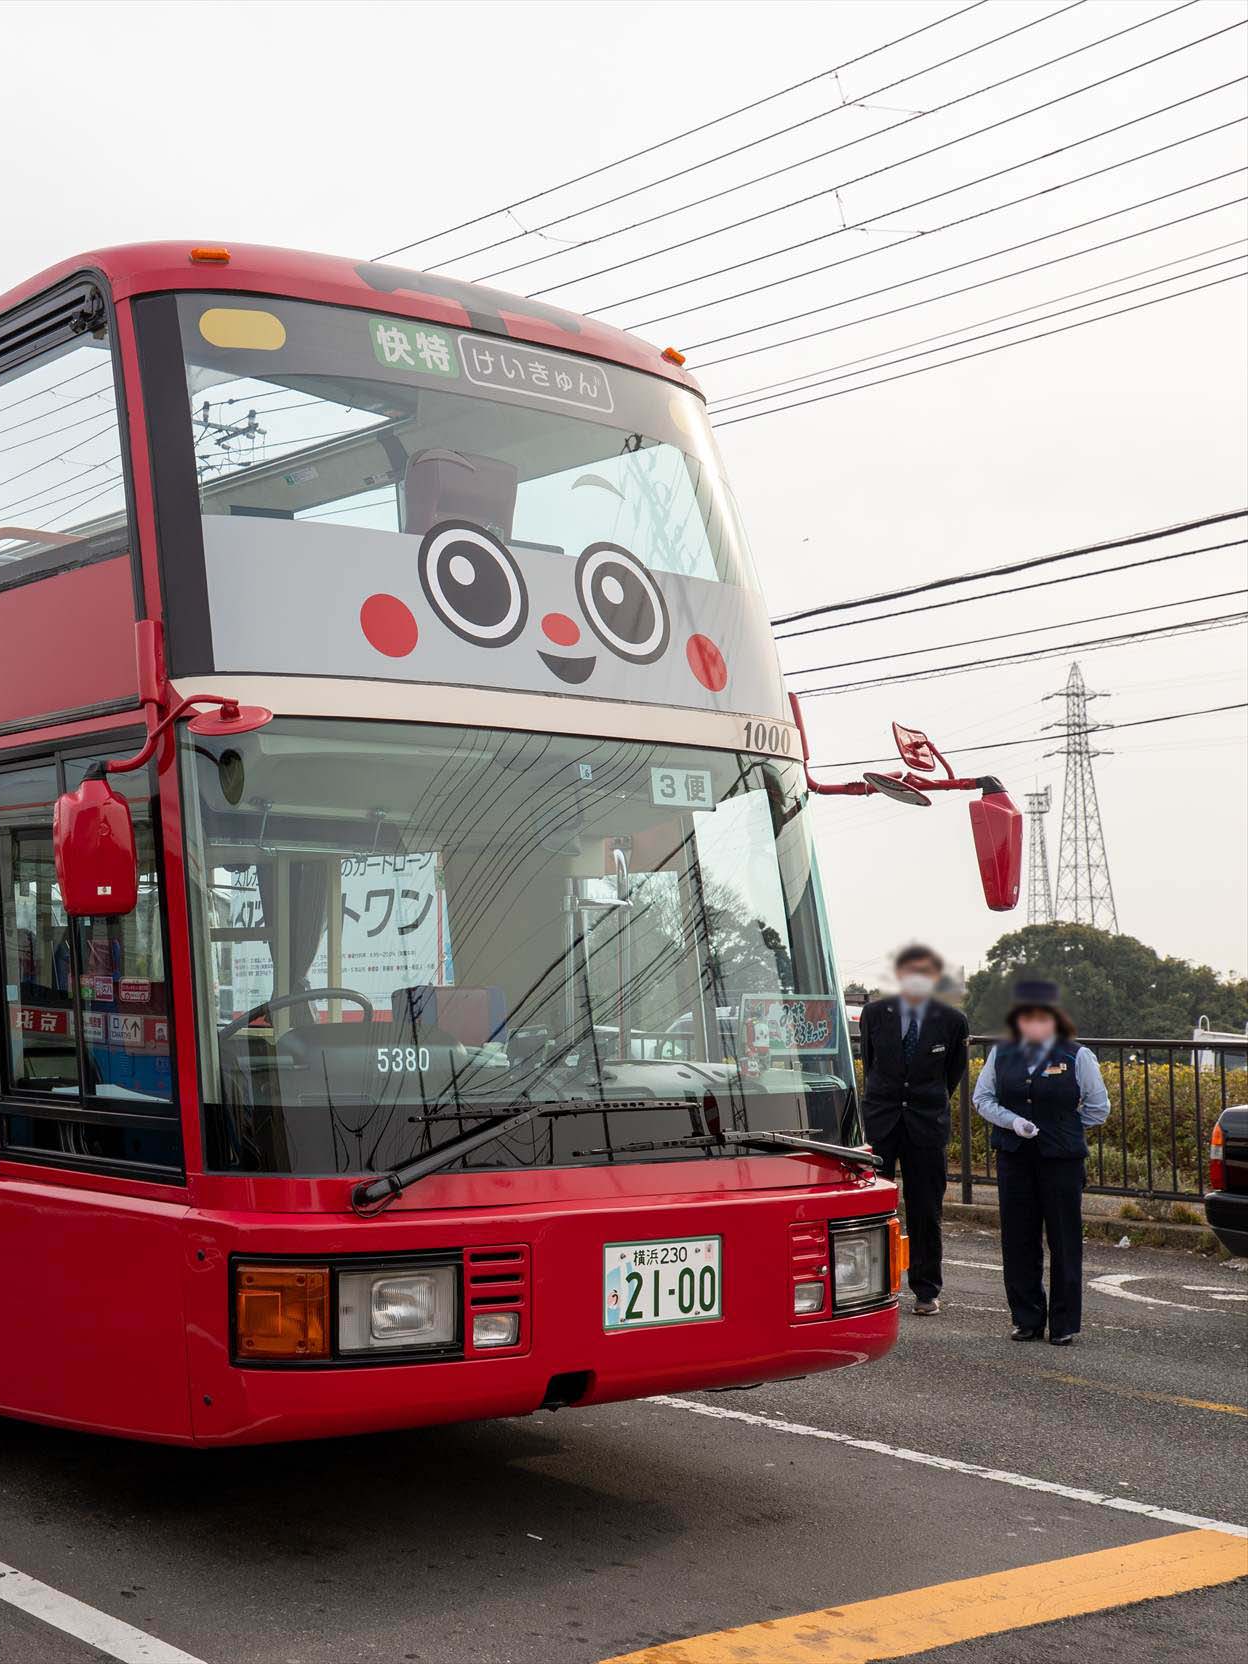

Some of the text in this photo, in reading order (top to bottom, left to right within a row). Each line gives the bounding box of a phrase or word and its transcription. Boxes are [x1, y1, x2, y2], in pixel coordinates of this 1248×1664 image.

[376, 324, 450, 371] 快特
[472, 348, 600, 399] けいきゅん
[743, 721, 791, 755] 1000
[377, 1047, 429, 1073] 5380
[625, 1265, 716, 1320] 21-00
